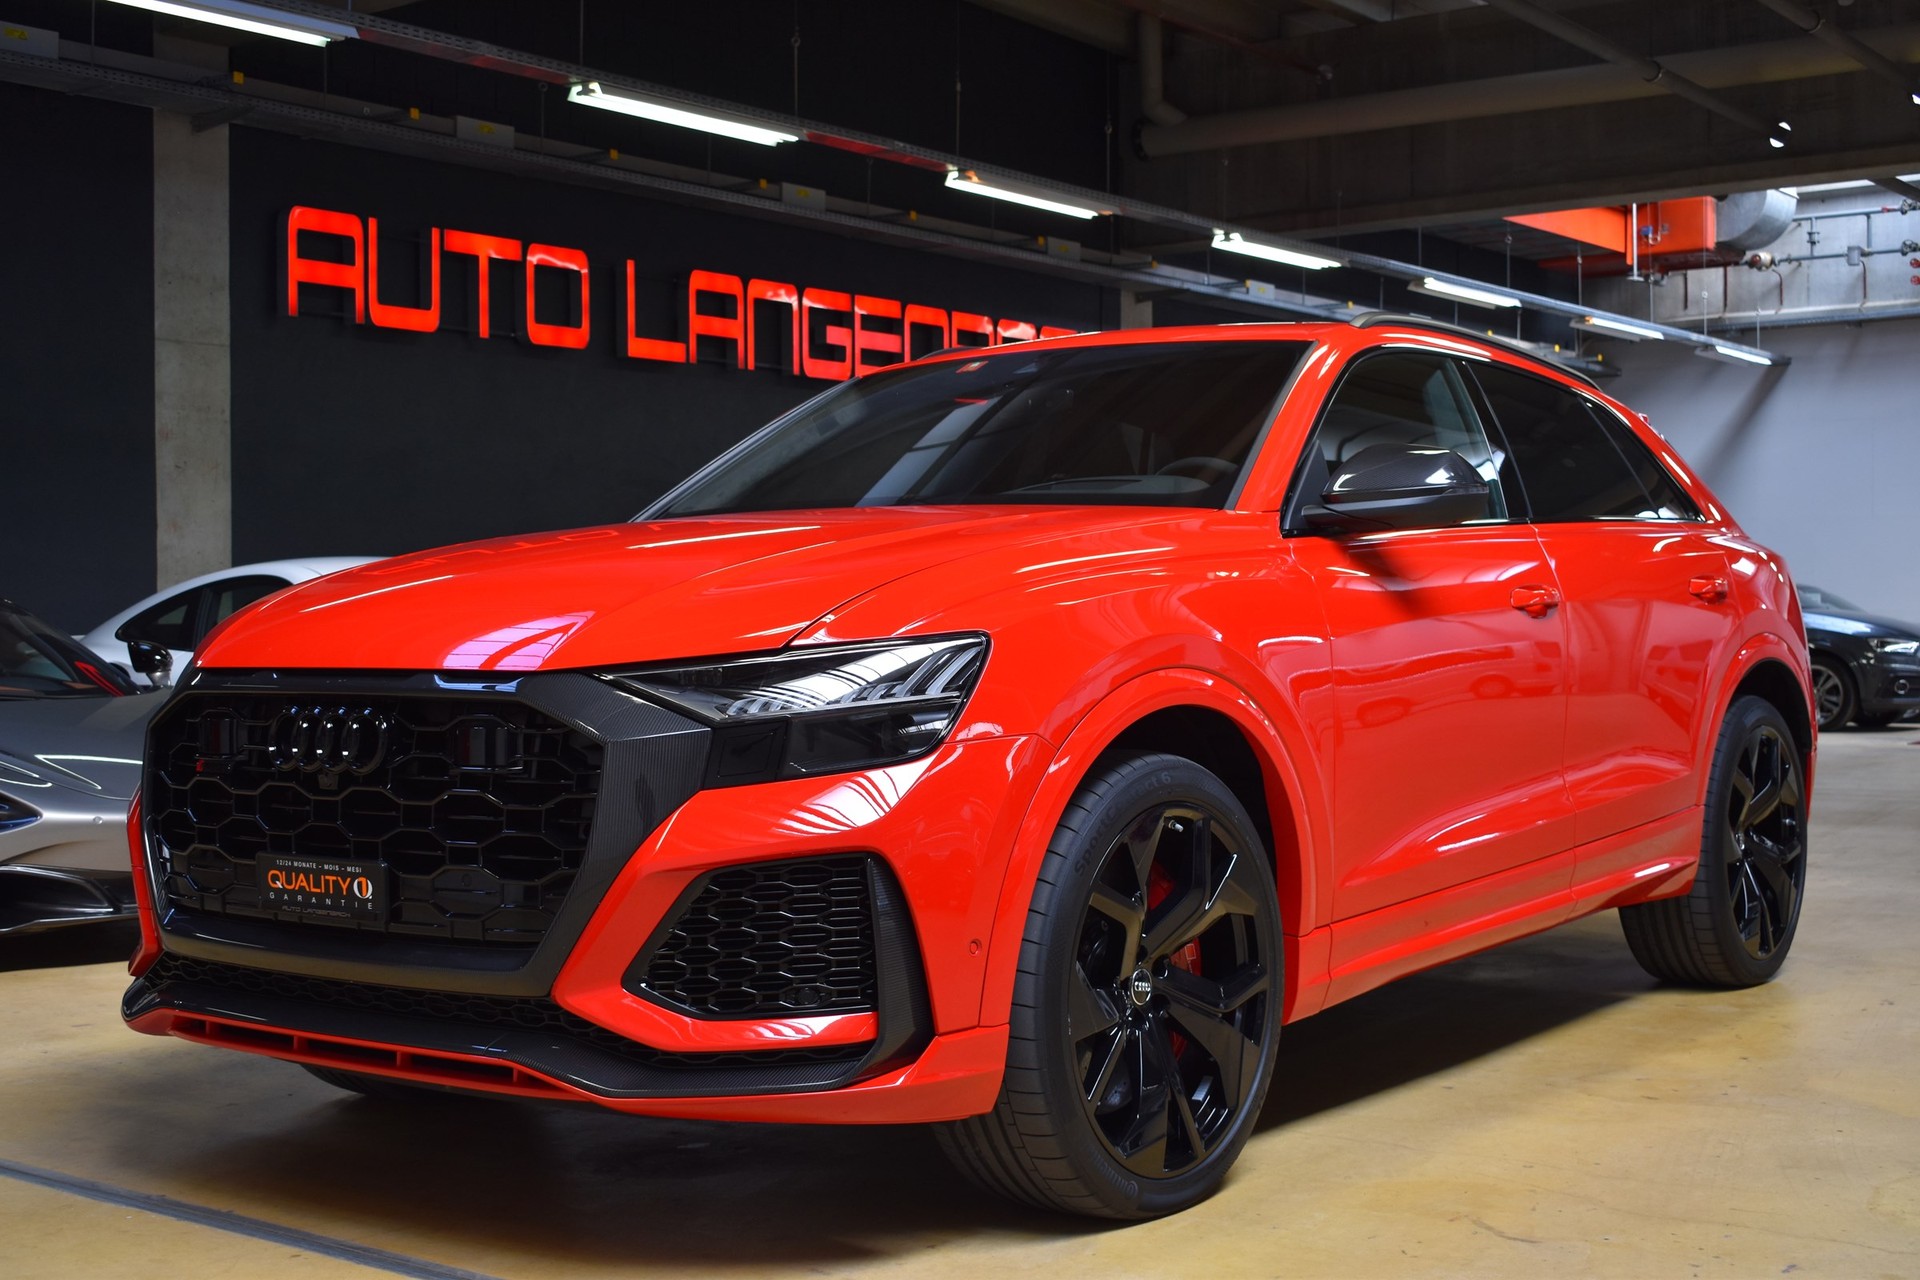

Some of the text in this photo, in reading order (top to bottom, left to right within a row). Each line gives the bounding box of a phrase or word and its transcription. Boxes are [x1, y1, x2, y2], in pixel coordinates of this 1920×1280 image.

[286, 205, 1084, 382] AUTO LANGEN
[276, 859, 292, 867] 12/24
[293, 861, 317, 869] MONATE
[267, 869, 352, 896] QUALITY
[269, 891, 373, 910] GARANTIE
